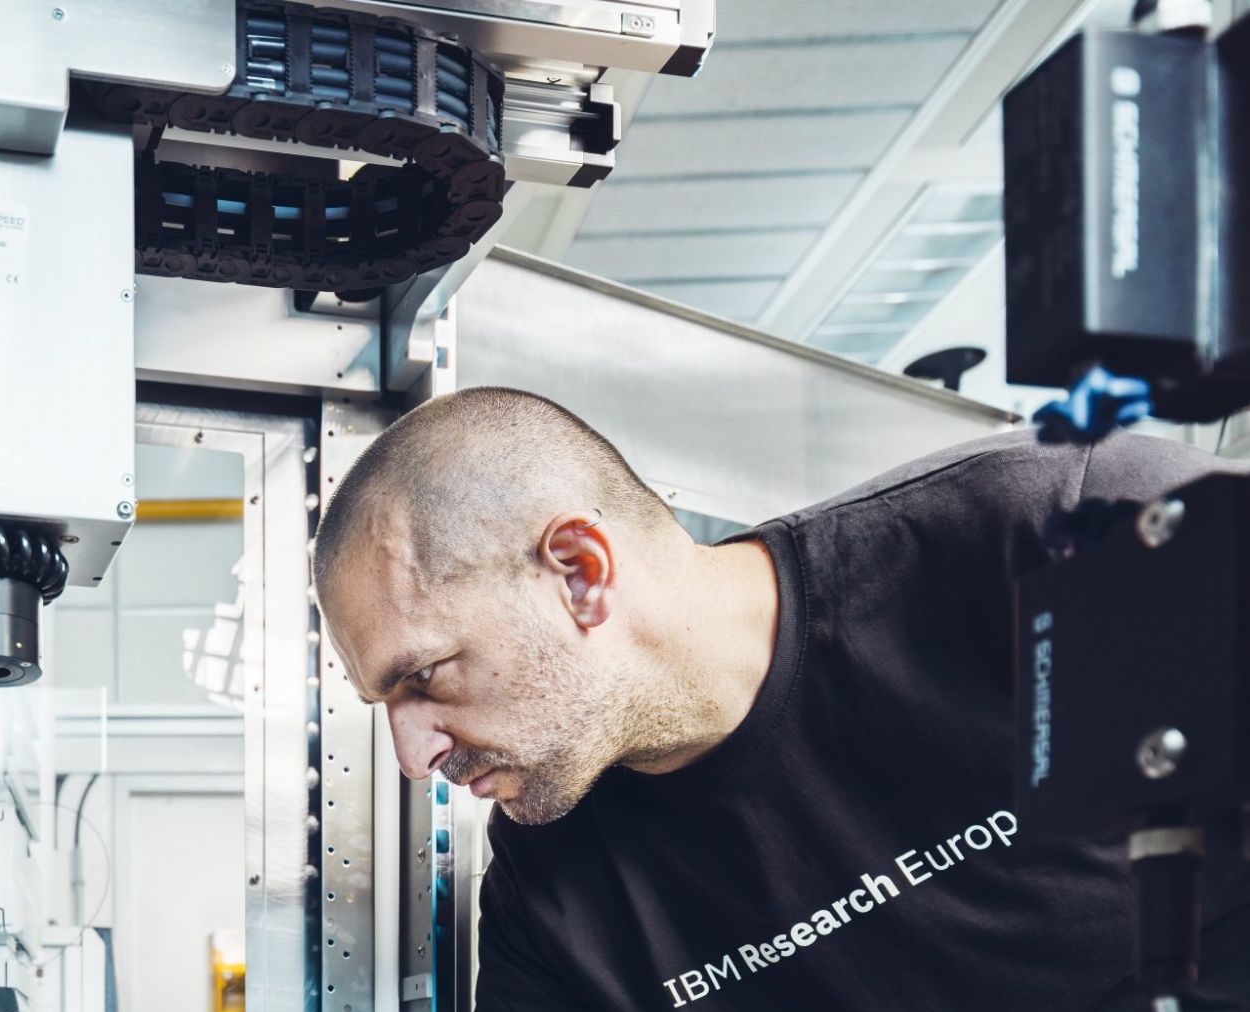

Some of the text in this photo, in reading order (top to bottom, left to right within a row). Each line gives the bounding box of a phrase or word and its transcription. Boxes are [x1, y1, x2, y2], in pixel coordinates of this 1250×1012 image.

[662, 810, 1019, 1009] IBM Research Europ
